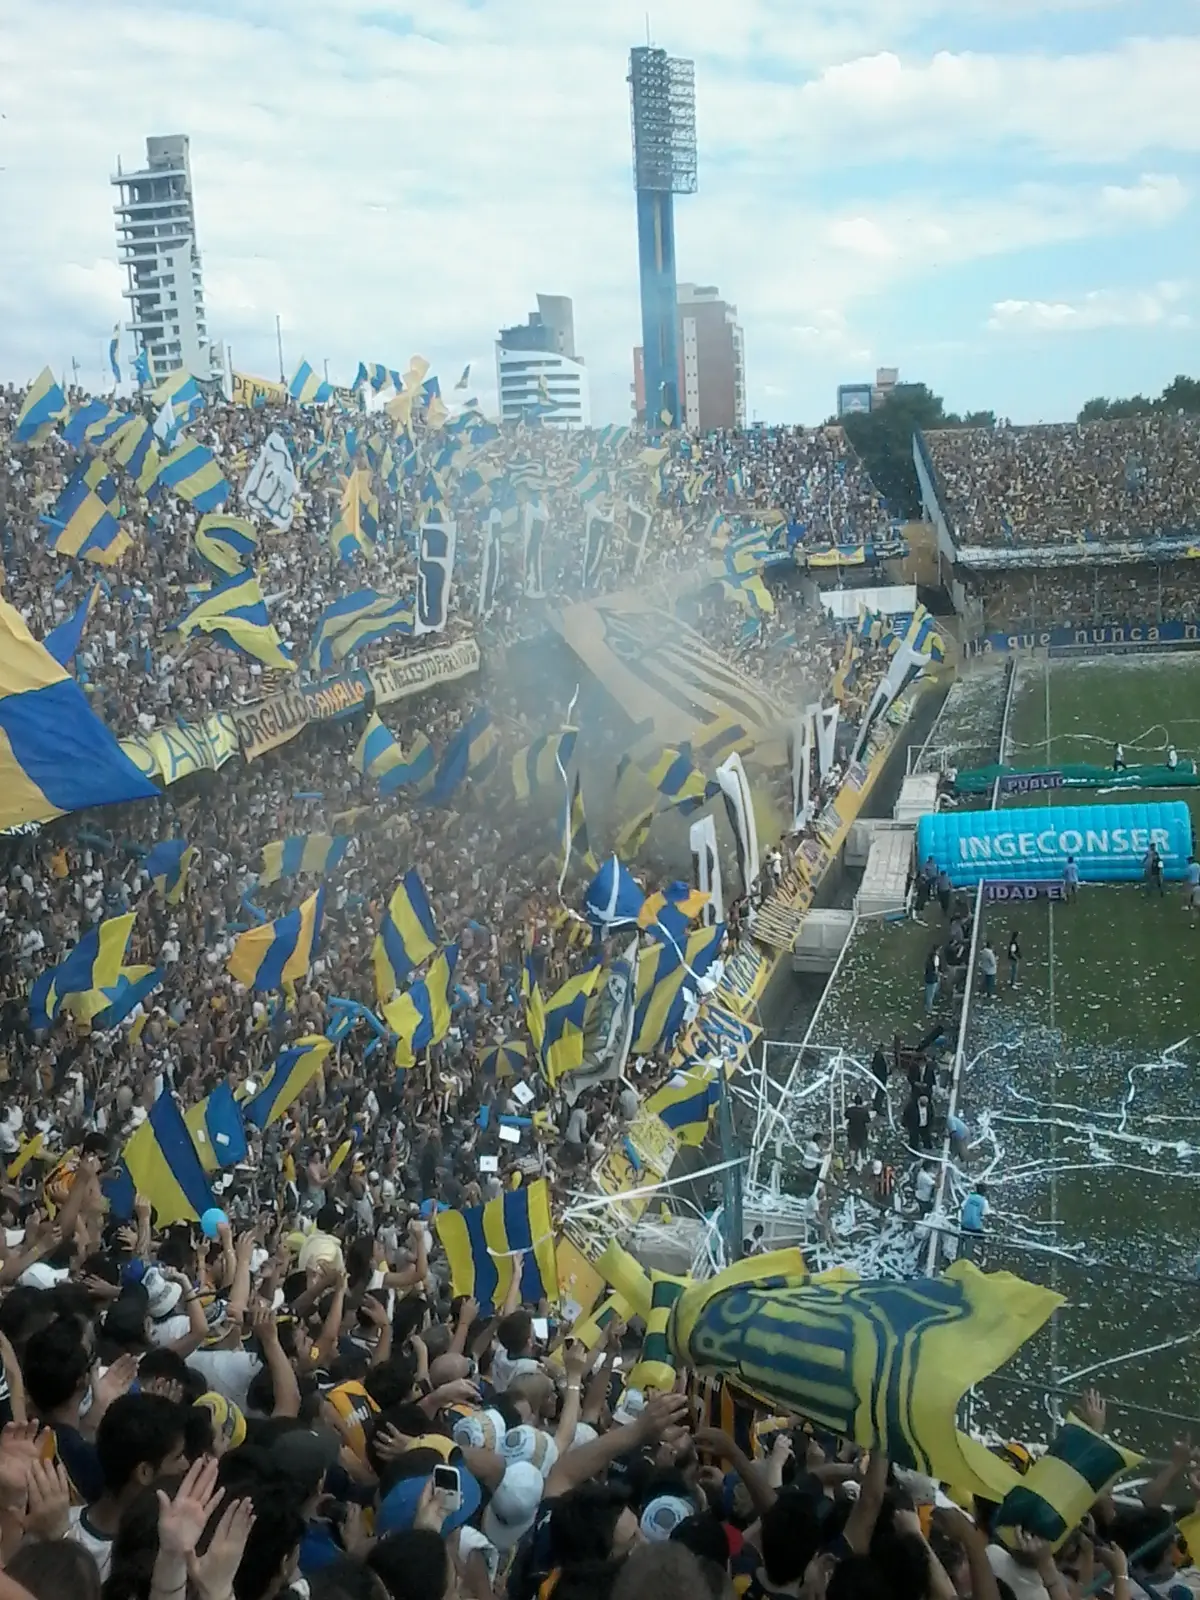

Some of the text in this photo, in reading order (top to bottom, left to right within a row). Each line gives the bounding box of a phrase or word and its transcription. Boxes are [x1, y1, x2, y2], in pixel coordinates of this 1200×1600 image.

[1007, 633, 1051, 649] que
[1075, 626, 1161, 644] nunca
[238, 693, 309, 748] ORGULLO
[959, 827, 1170, 860] INGECONSER
